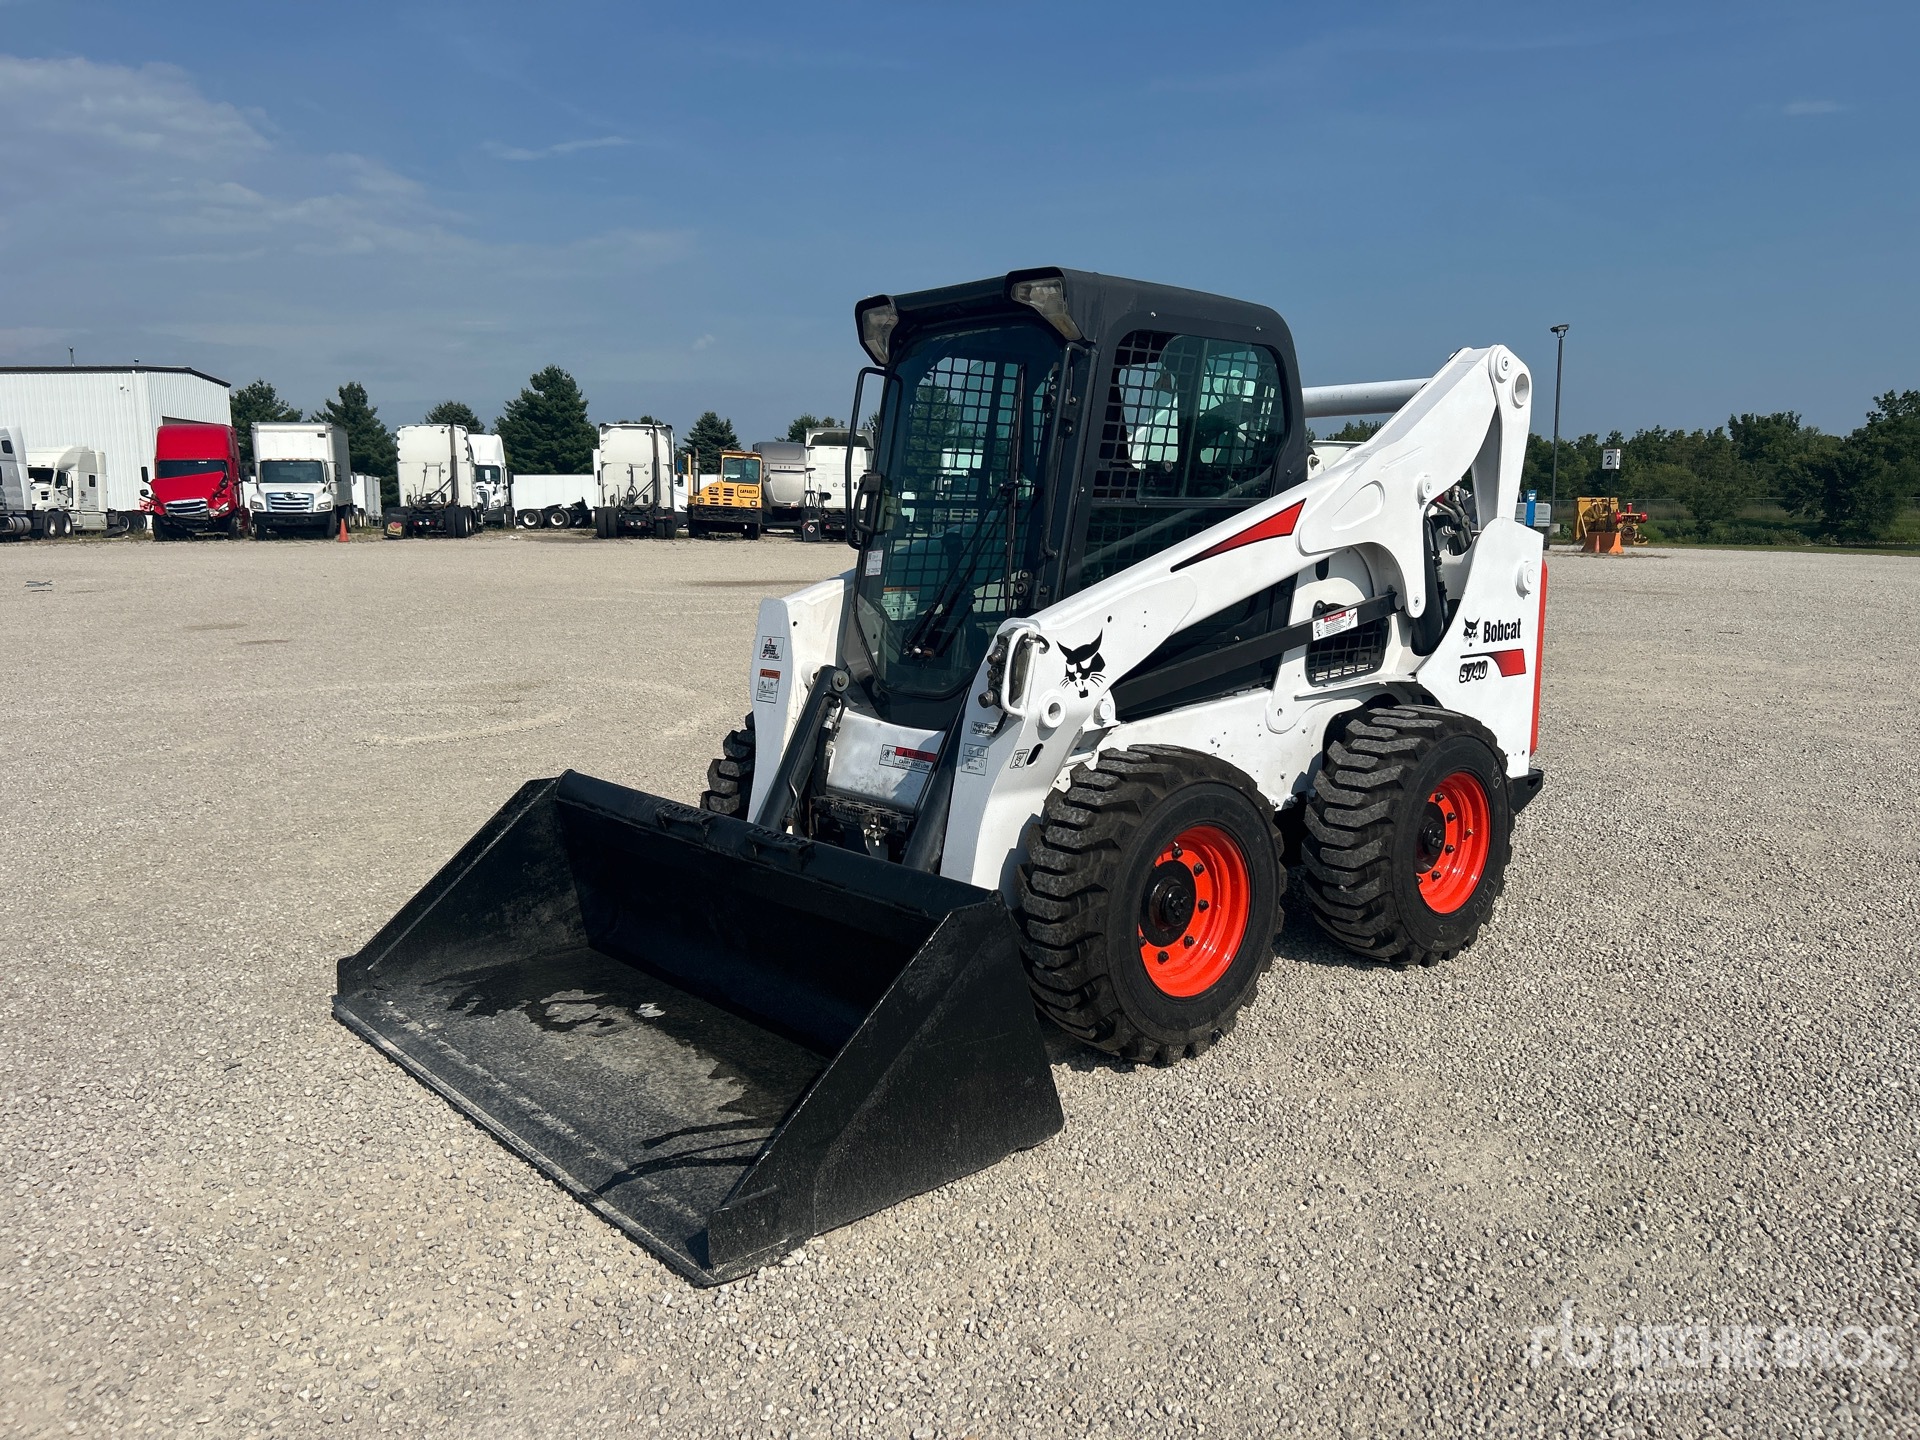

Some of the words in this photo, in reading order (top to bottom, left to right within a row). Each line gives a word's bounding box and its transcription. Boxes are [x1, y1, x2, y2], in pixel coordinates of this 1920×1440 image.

[1606, 455, 1612, 465] 2
[1483, 618, 1521, 643] Bobcat
[1459, 660, 1488, 683] S740
